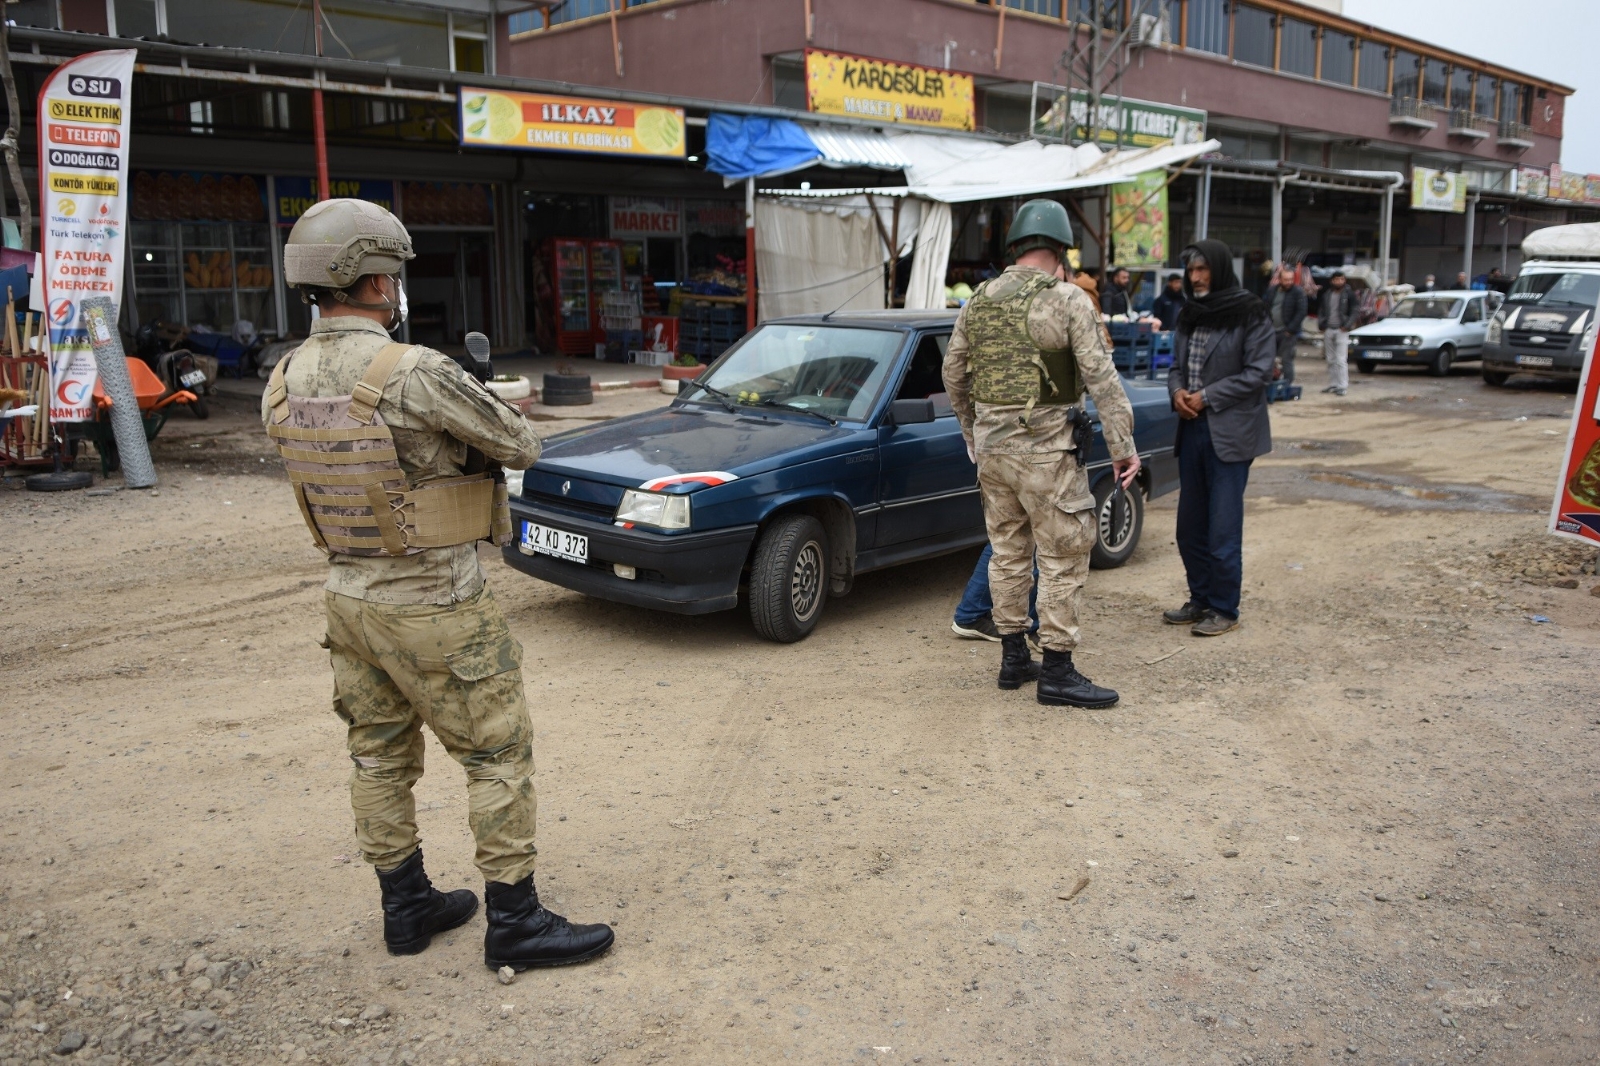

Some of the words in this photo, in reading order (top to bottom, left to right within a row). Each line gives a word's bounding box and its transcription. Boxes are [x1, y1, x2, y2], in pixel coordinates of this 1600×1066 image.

[88, 80, 112, 94] SU
[66, 103, 120, 120] ELEKTRİK
[541, 104, 616, 126] İLKAY
[843, 97, 892, 118] MARKET
[894, 102, 904, 119] &
[905, 105, 943, 123] MANAV
[66, 128, 118, 144] TELEFON
[526, 128, 570, 145] EKMEK
[572, 131, 633, 149] FABRİKASI
[63, 152, 118, 168] DOĞALGAZ
[54, 178, 84, 189] KONTÖR
[86, 180, 116, 191] YÜKLEME
[309, 178, 361, 197] İKAY
[612, 211, 679, 232] MARKET
[50, 229, 69, 238] Türk
[71, 230, 105, 240] Telekom
[54, 250, 113, 262] FATURA
[59, 263, 107, 277] ÖDEME
[51, 280, 114, 292] MERKEZİ
[528, 525, 540, 544] 42
[546, 529, 559, 549] KD
[565, 534, 586, 556] 373
